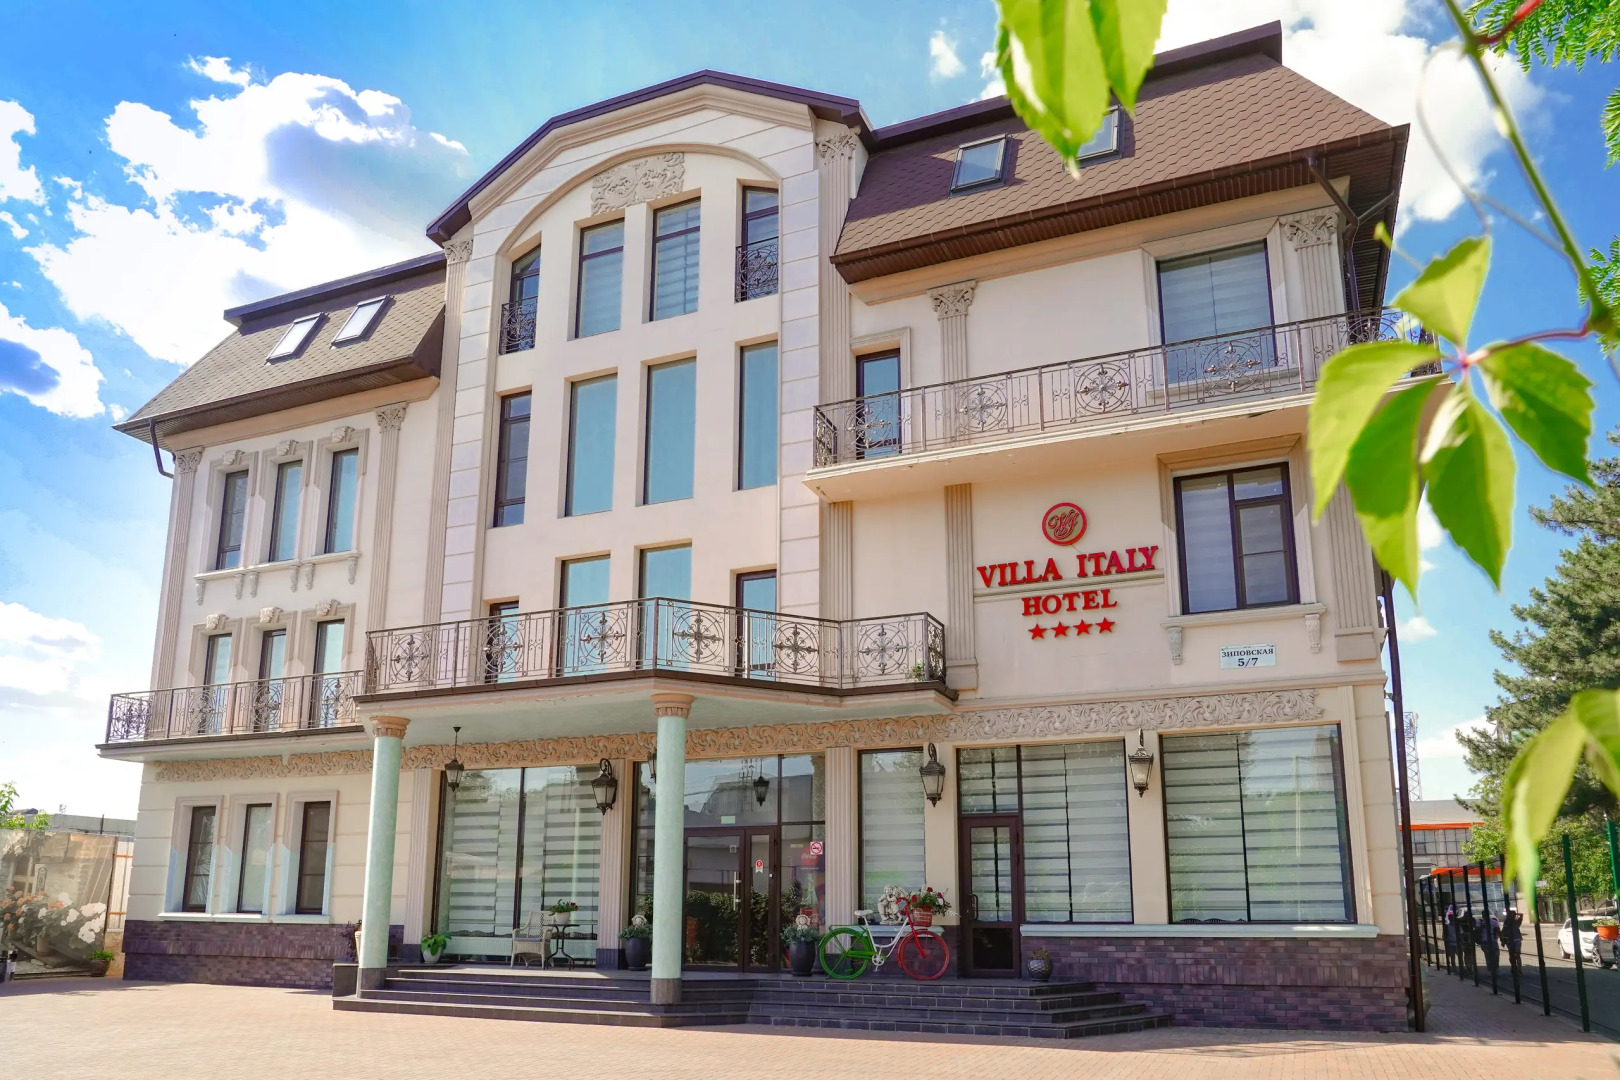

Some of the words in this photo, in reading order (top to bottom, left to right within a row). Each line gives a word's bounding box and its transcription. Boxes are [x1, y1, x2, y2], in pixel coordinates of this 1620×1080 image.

[977, 558, 1062, 587] VILLA
[1076, 546, 1158, 578] ITALY
[1022, 589, 1118, 616] HOTEL
[1221, 648, 1274, 658] ЗИПОВСКАЯ
[1238, 657, 1258, 667] 5/7
